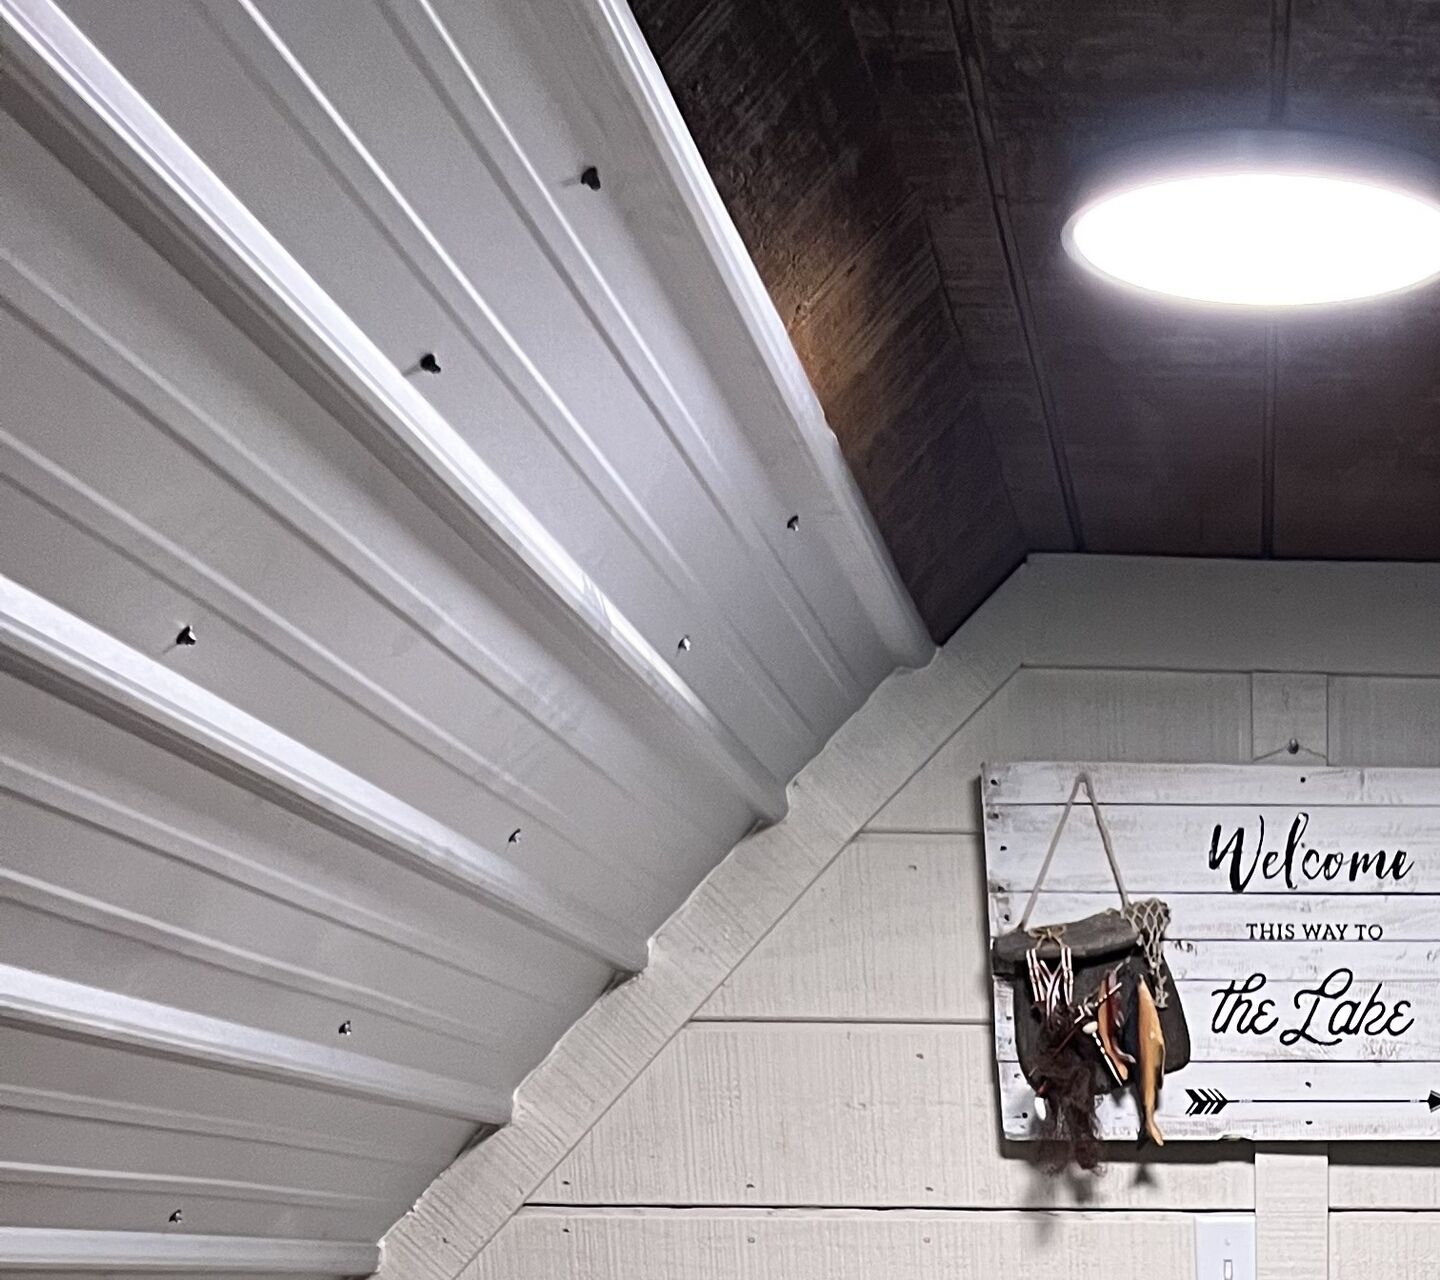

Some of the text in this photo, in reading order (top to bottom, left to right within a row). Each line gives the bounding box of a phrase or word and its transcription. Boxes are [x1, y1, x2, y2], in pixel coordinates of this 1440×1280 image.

[1208, 812, 1415, 893] Welcome
[1246, 923, 1383, 941] THIS WAY TO
[1211, 968, 1415, 1046] the Lake
